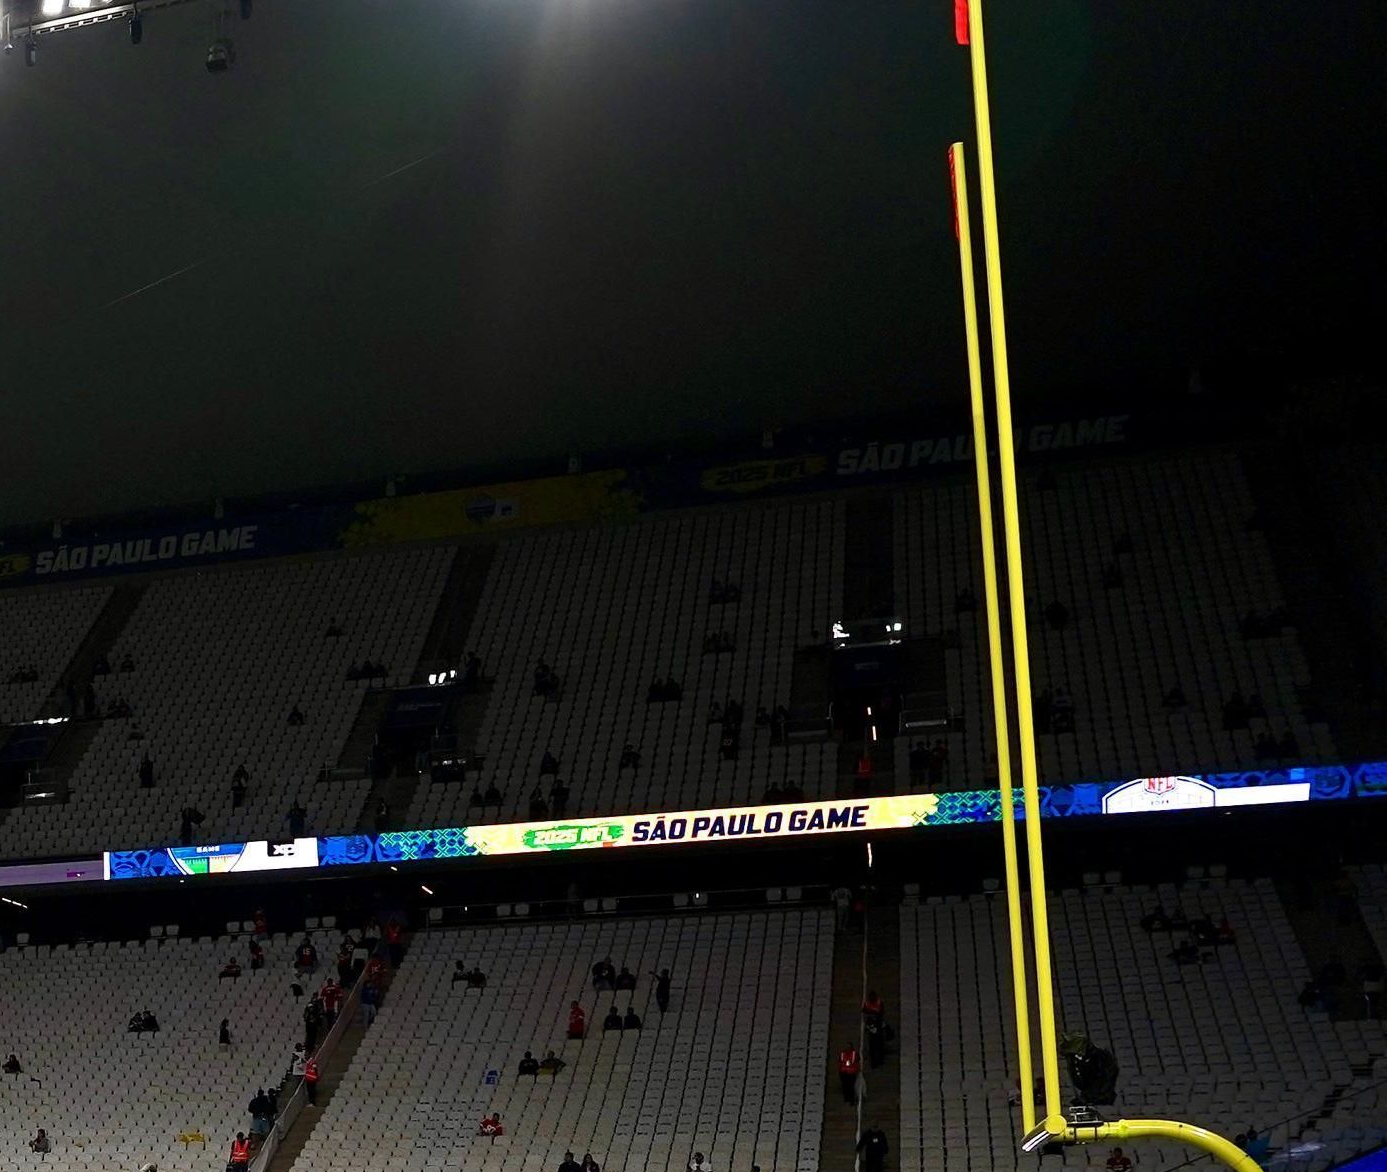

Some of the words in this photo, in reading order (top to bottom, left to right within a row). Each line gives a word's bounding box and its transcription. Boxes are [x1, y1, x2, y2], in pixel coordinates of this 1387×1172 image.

[835, 442, 905, 476] SÃO
[908, 430, 1022, 467] PAU
[1027, 413, 1129, 451] GAME
[35, 545, 87, 575] SÃO
[90, 536, 176, 568] PAULO
[180, 525, 258, 557] GAME
[1147, 777, 1173, 791] NFL
[631, 816, 687, 842] SÃO
[691, 812, 783, 839] PAULO
[787, 805, 870, 832] GAME
